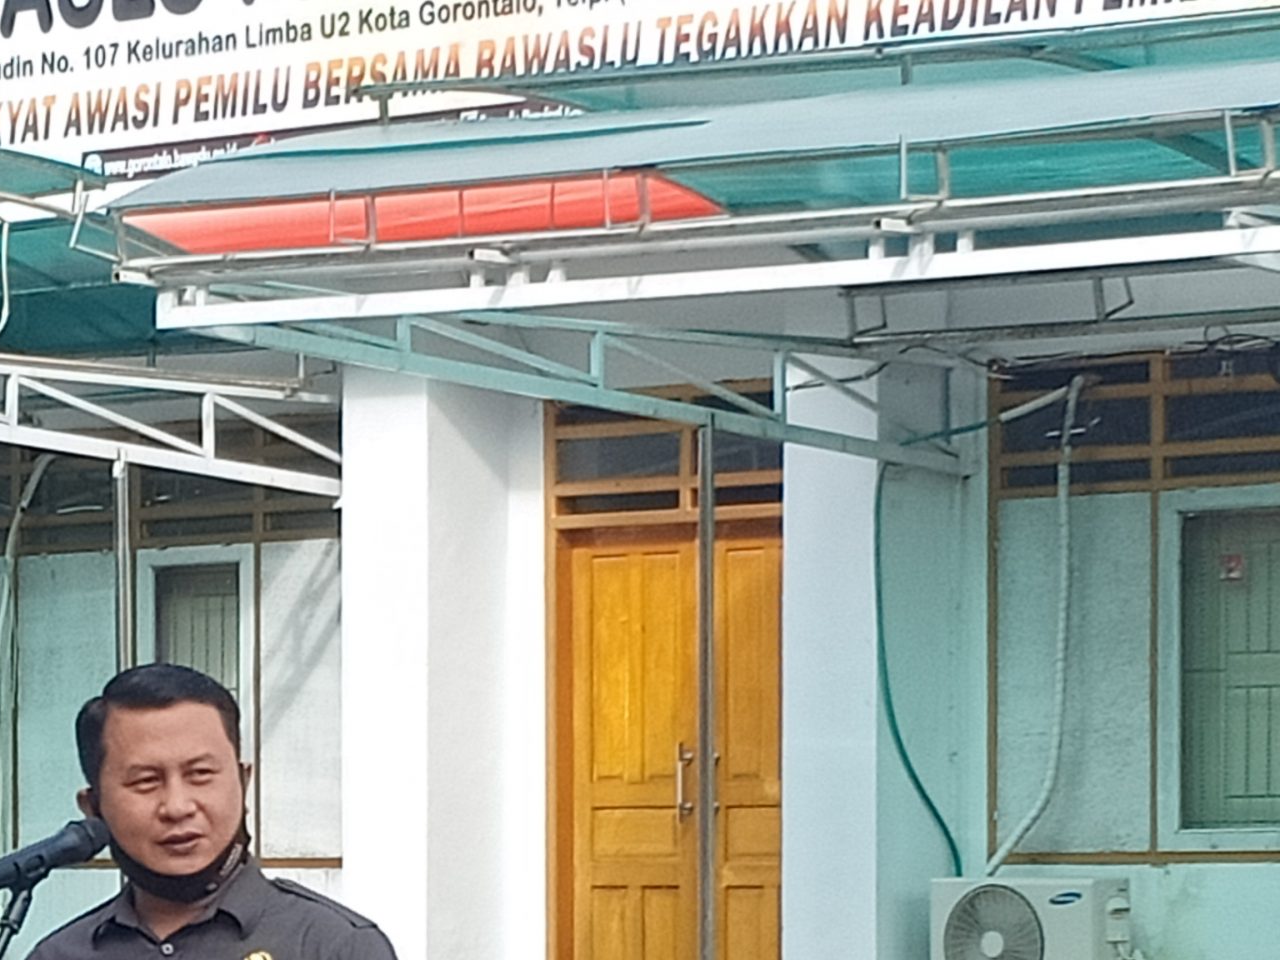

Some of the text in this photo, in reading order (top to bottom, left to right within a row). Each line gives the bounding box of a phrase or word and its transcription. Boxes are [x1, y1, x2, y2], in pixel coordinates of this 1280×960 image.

[41, 51, 74, 75] No.
[83, 43, 119, 70] 107
[127, 32, 237, 64] Kelurahan
[245, 19, 312, 48] Limba
[320, 11, 350, 39] U2
[358, 6, 410, 35] Kota
[419, 0, 544, 25] Gorontalo,
[63, 82, 161, 138] AWASI
[172, 65, 291, 125] PEMILU
[302, 43, 462, 110] BERSAMA
[475, 20, 642, 78] BAWASLU
[656, 0, 850, 64] TEGAKKAN
